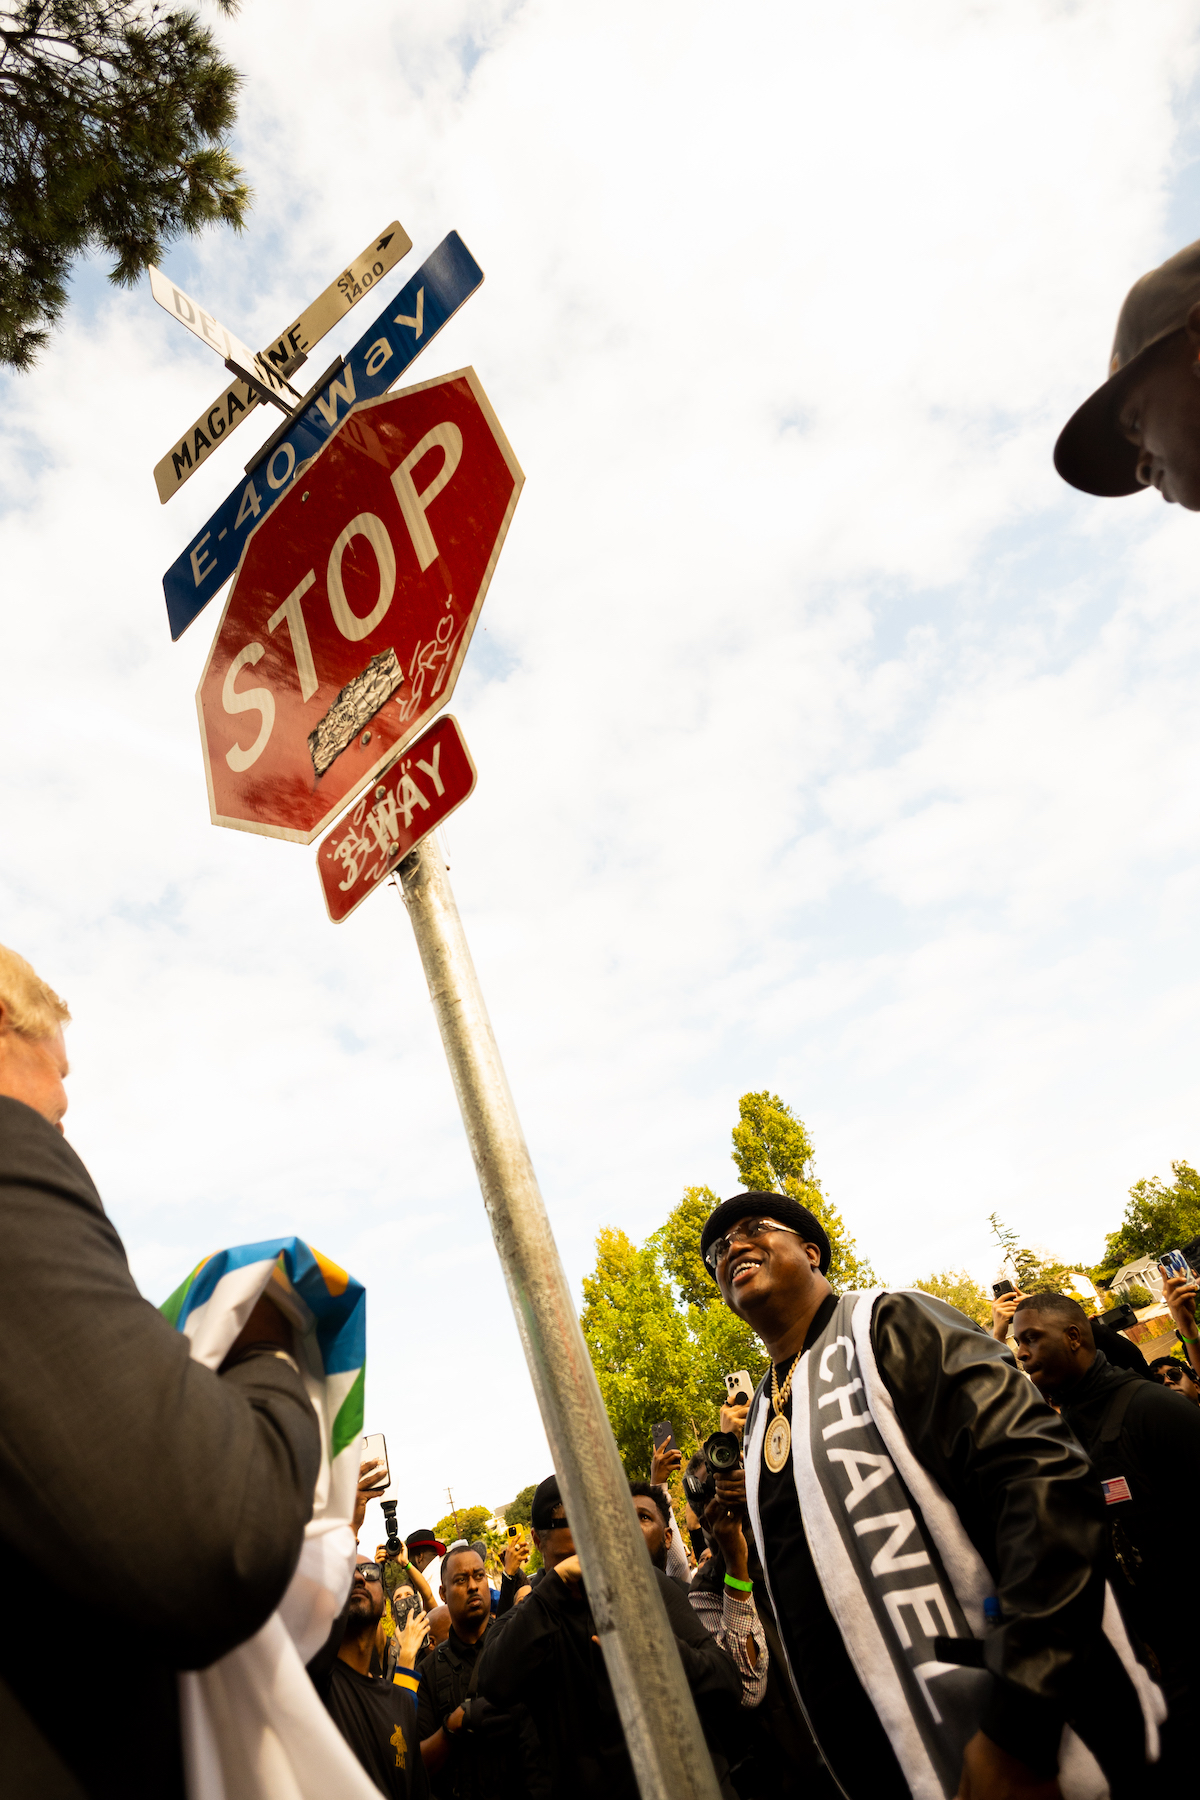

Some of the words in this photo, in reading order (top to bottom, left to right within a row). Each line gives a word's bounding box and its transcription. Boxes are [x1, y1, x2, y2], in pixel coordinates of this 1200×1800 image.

[337, 269, 355, 293] ST
[344, 262, 384, 304] 1400
[171, 323, 309, 481] MAGAZNE
[190, 442, 295, 588] E-40
[315, 286, 424, 427] Way
[222, 421, 463, 773] STOP
[818, 1334, 964, 1724] CHANEL
